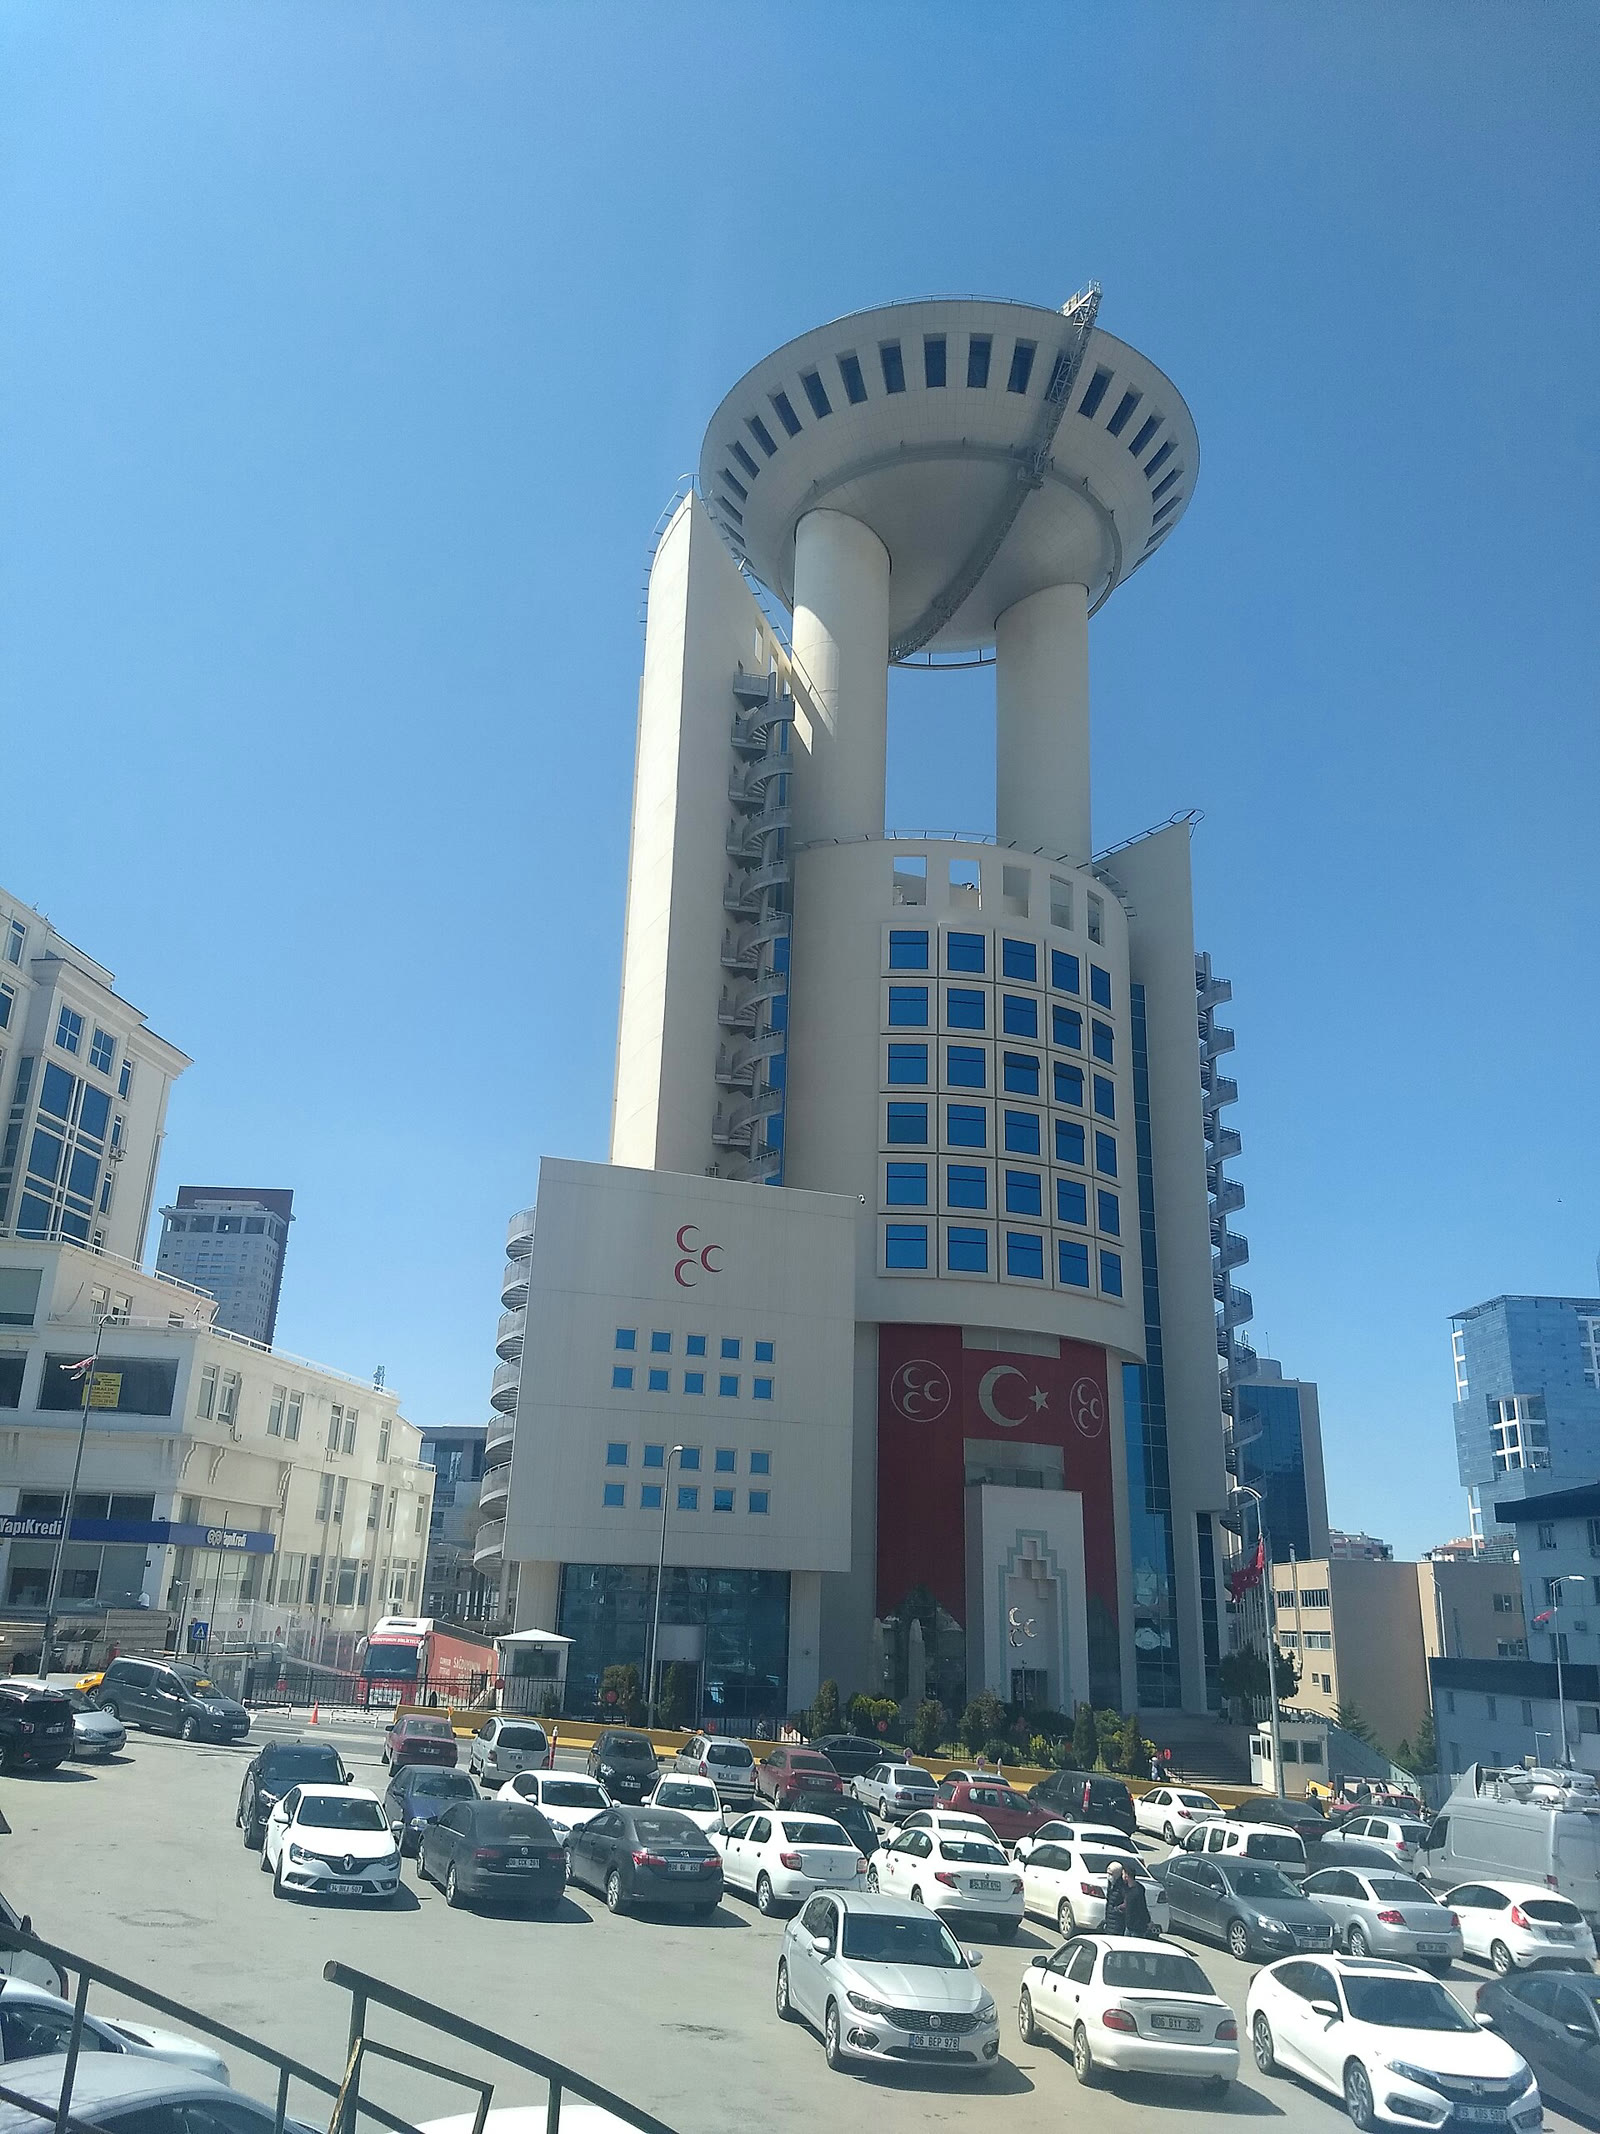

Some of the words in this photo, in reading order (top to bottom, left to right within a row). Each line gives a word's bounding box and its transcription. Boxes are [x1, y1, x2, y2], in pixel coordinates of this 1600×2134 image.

[0, 1518, 62, 1536] YapıKredi
[914, 2035, 924, 2045] 06
[928, 2036, 942, 2046] BEP
[944, 2038, 958, 2048] 978
